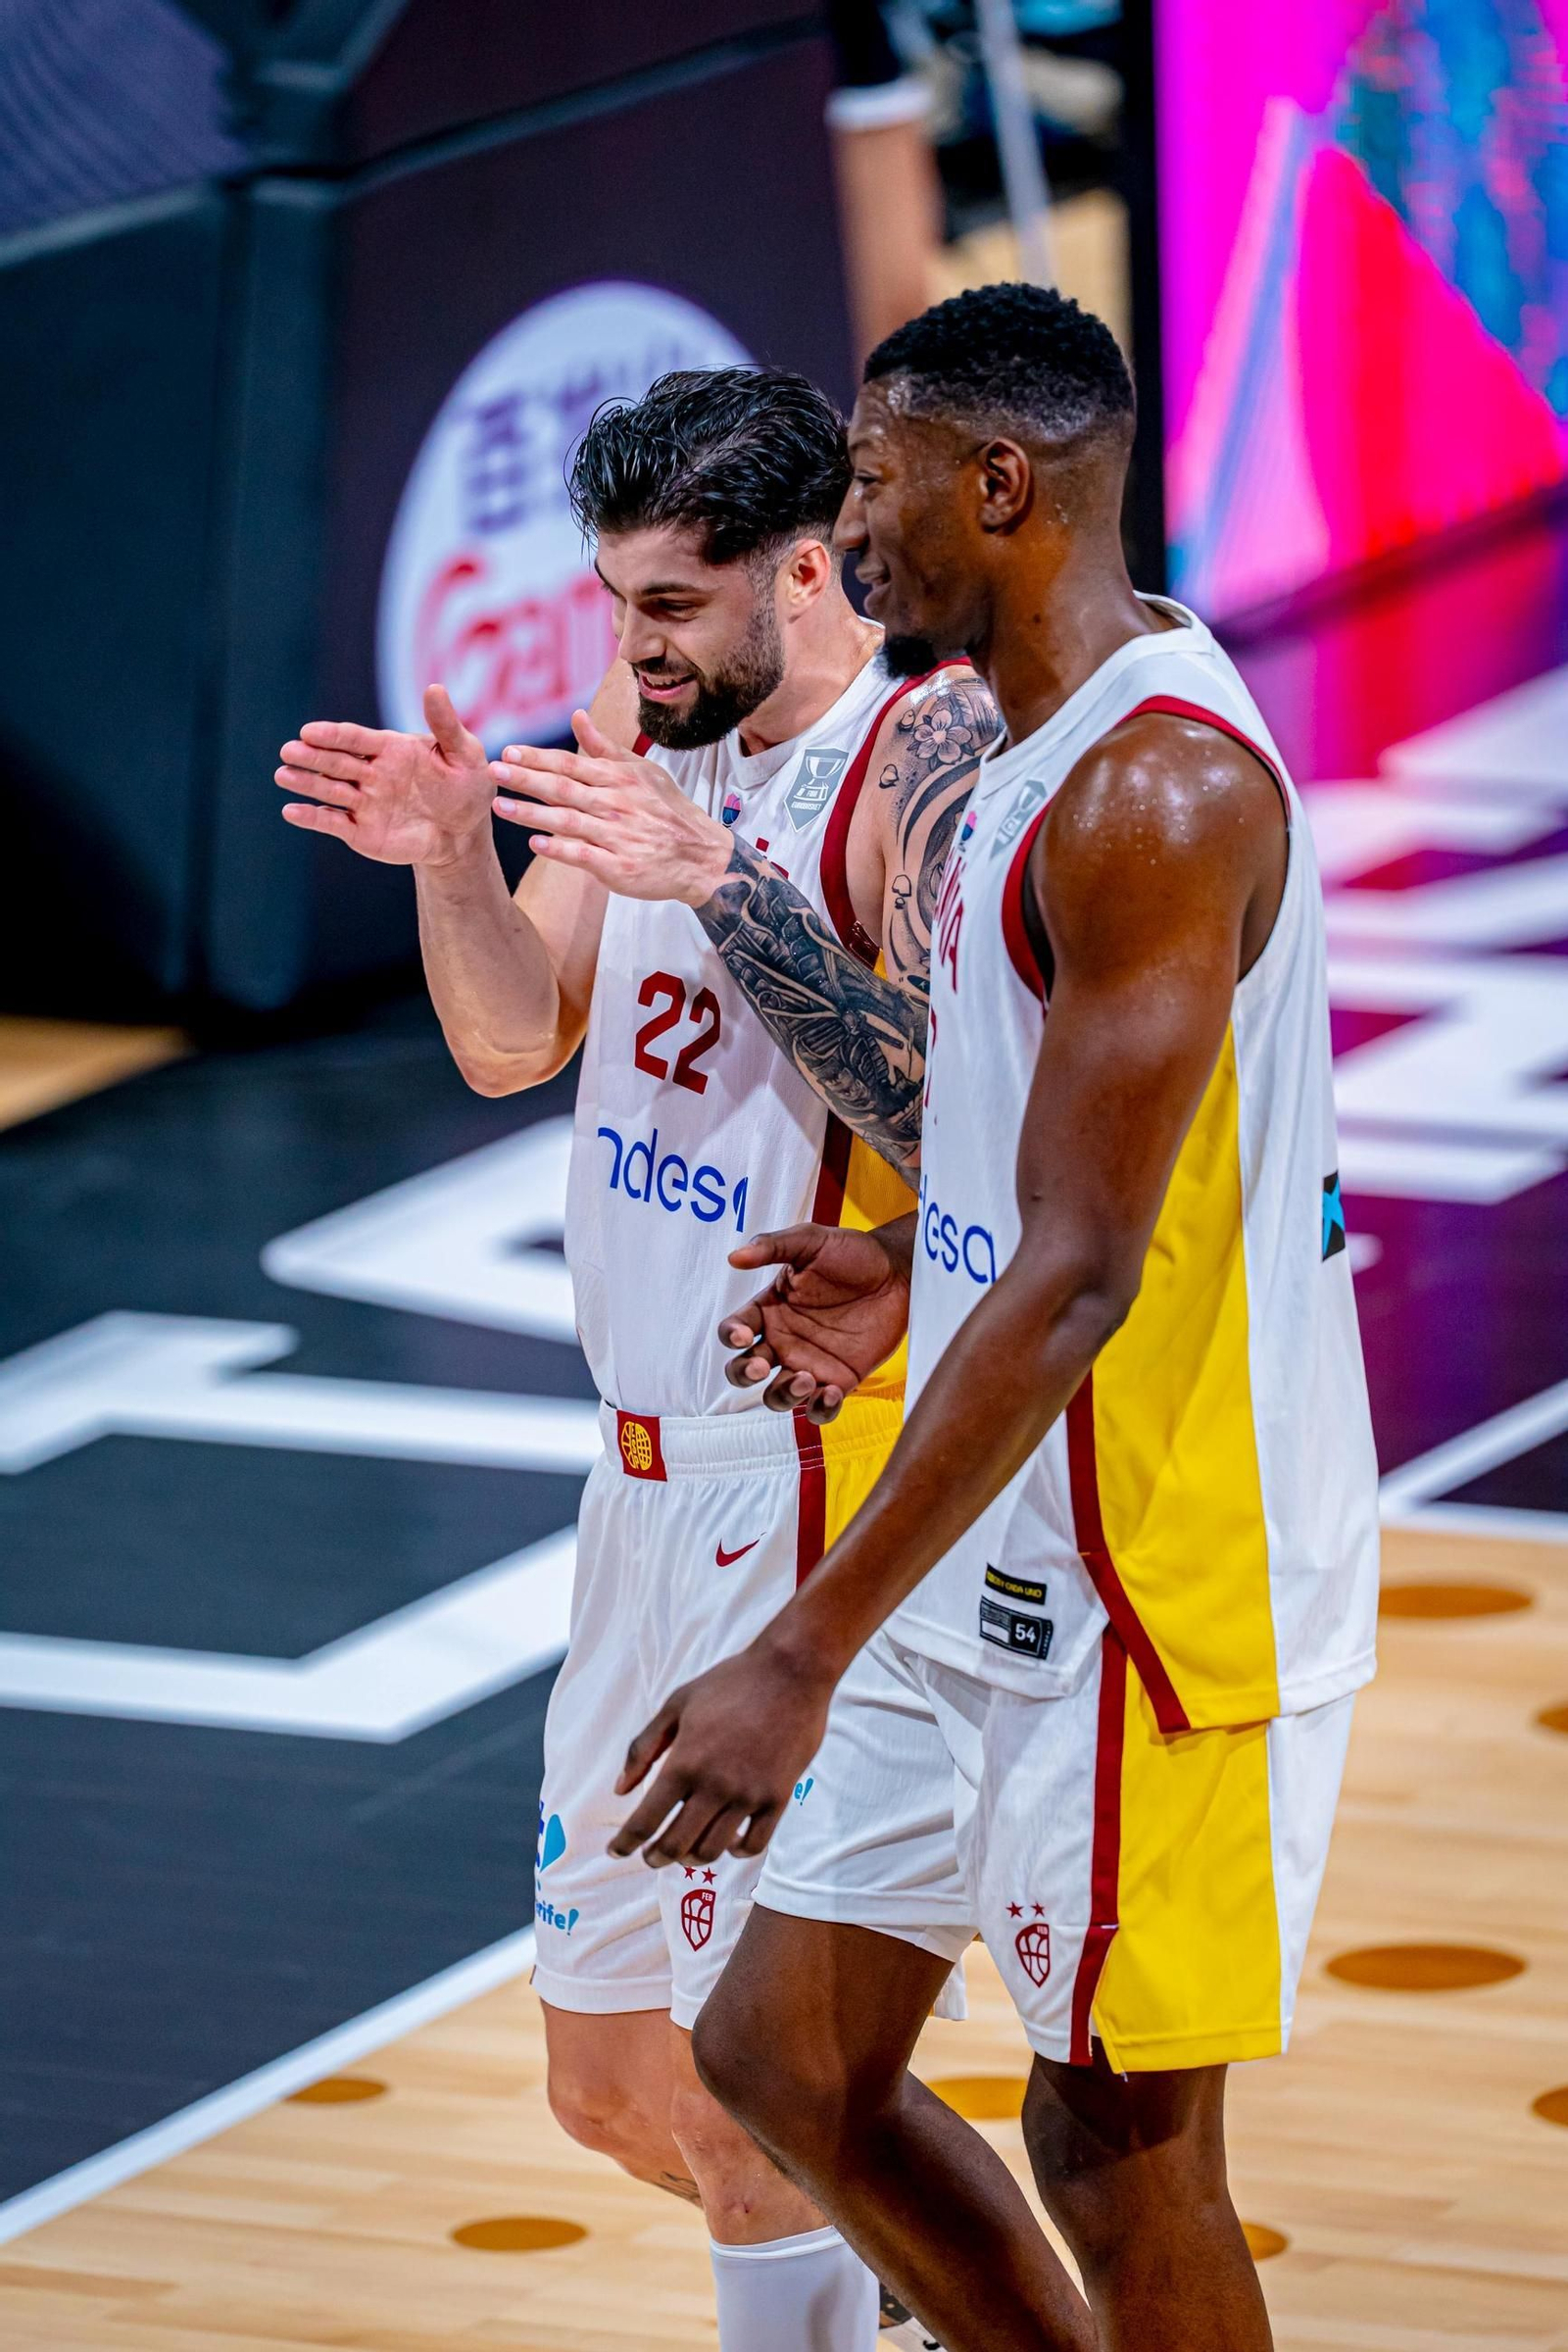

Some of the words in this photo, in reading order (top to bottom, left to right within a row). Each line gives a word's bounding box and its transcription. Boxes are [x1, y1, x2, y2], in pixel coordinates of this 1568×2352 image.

[634, 970, 721, 1096] 22
[1014, 1623, 1037, 1643] 54
[701, 1891, 714, 1902] FEB
